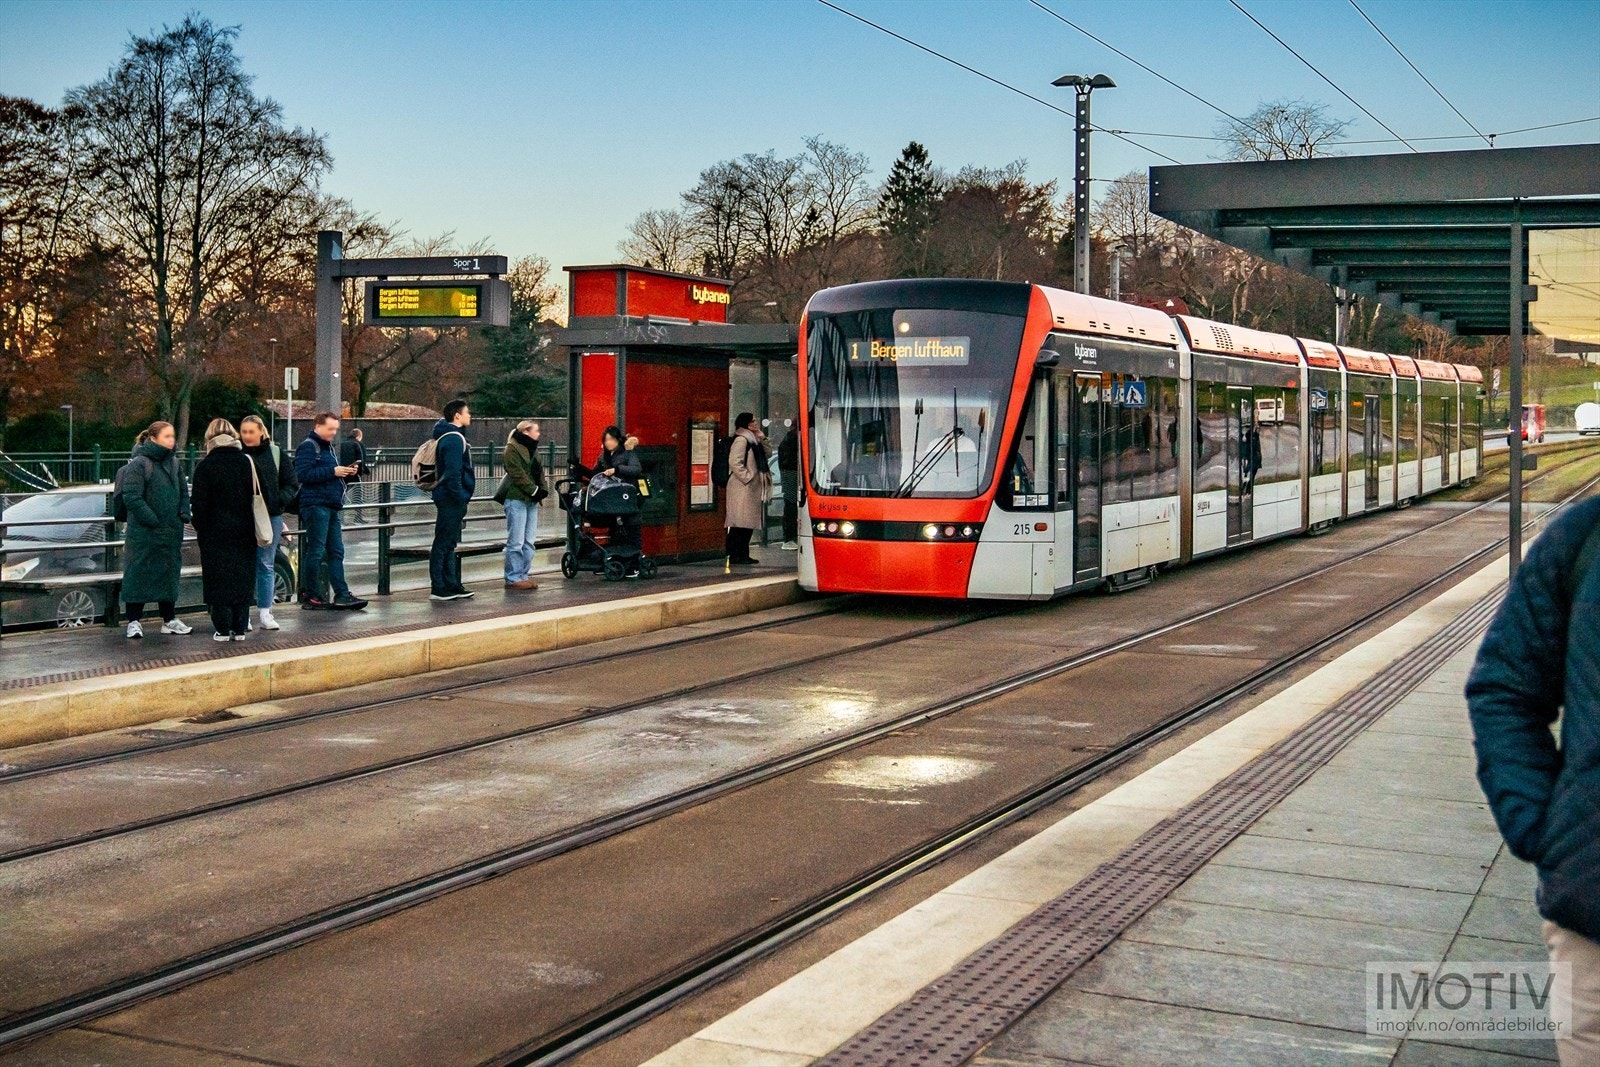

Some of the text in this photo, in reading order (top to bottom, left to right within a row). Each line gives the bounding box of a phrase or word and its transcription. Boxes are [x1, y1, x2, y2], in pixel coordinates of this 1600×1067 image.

[453, 258, 480, 270] Spor 1
[379, 288, 397, 297] Bergen
[692, 284, 730, 304] bybanen
[379, 295, 397, 303] Bergen
[379, 302, 397, 310] Bergen
[851, 340, 964, 361] 1 Bergen lufthavn
[1074, 342, 1097, 360] bybanen
[818, 503, 841, 512] skyss
[1013, 523, 1031, 535] 215
